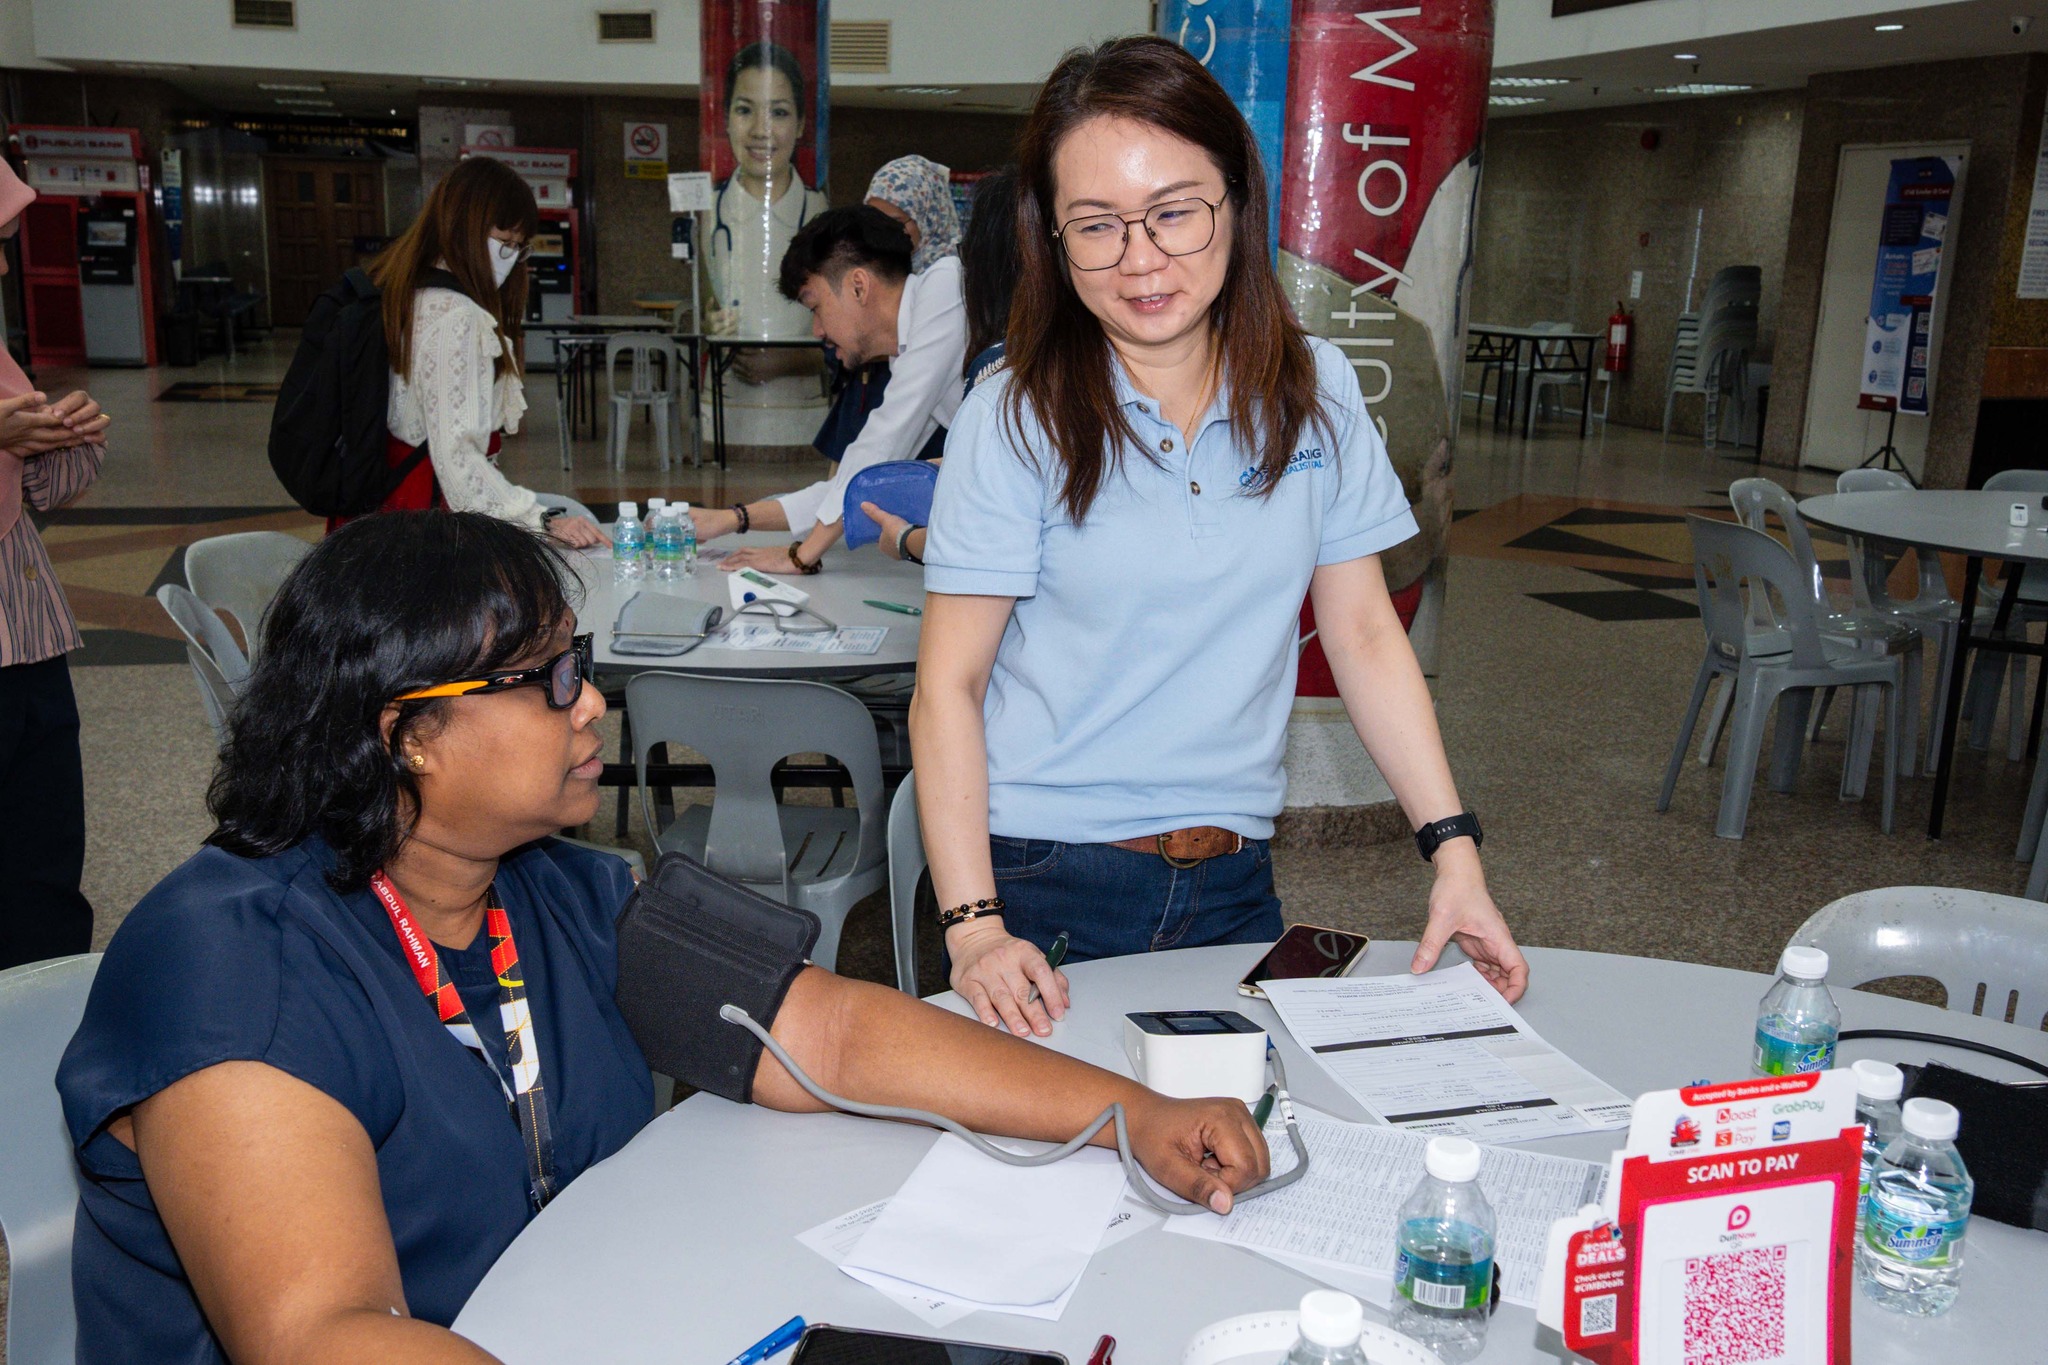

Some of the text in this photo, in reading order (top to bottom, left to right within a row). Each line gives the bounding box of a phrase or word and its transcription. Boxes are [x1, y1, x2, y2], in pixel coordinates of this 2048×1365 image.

[88, 139, 125, 149] BANK
[531, 161, 565, 169] BANK
[1342, 123, 1411, 217] of
[373, 880, 431, 969] ABDUL RAHMAN
[1692, 1080, 1809, 1102] Accepted by Banks and e-Wallets
[1772, 1099, 1826, 1114] GrabPay
[1735, 1133, 1756, 1145] Pay
[1686, 1153, 1800, 1184] SCAN TO PAY
[1576, 1247, 1627, 1268] DEALS
[1574, 1270, 1625, 1284] Check out our
[1574, 1278, 1625, 1293] #CIMBDeals
